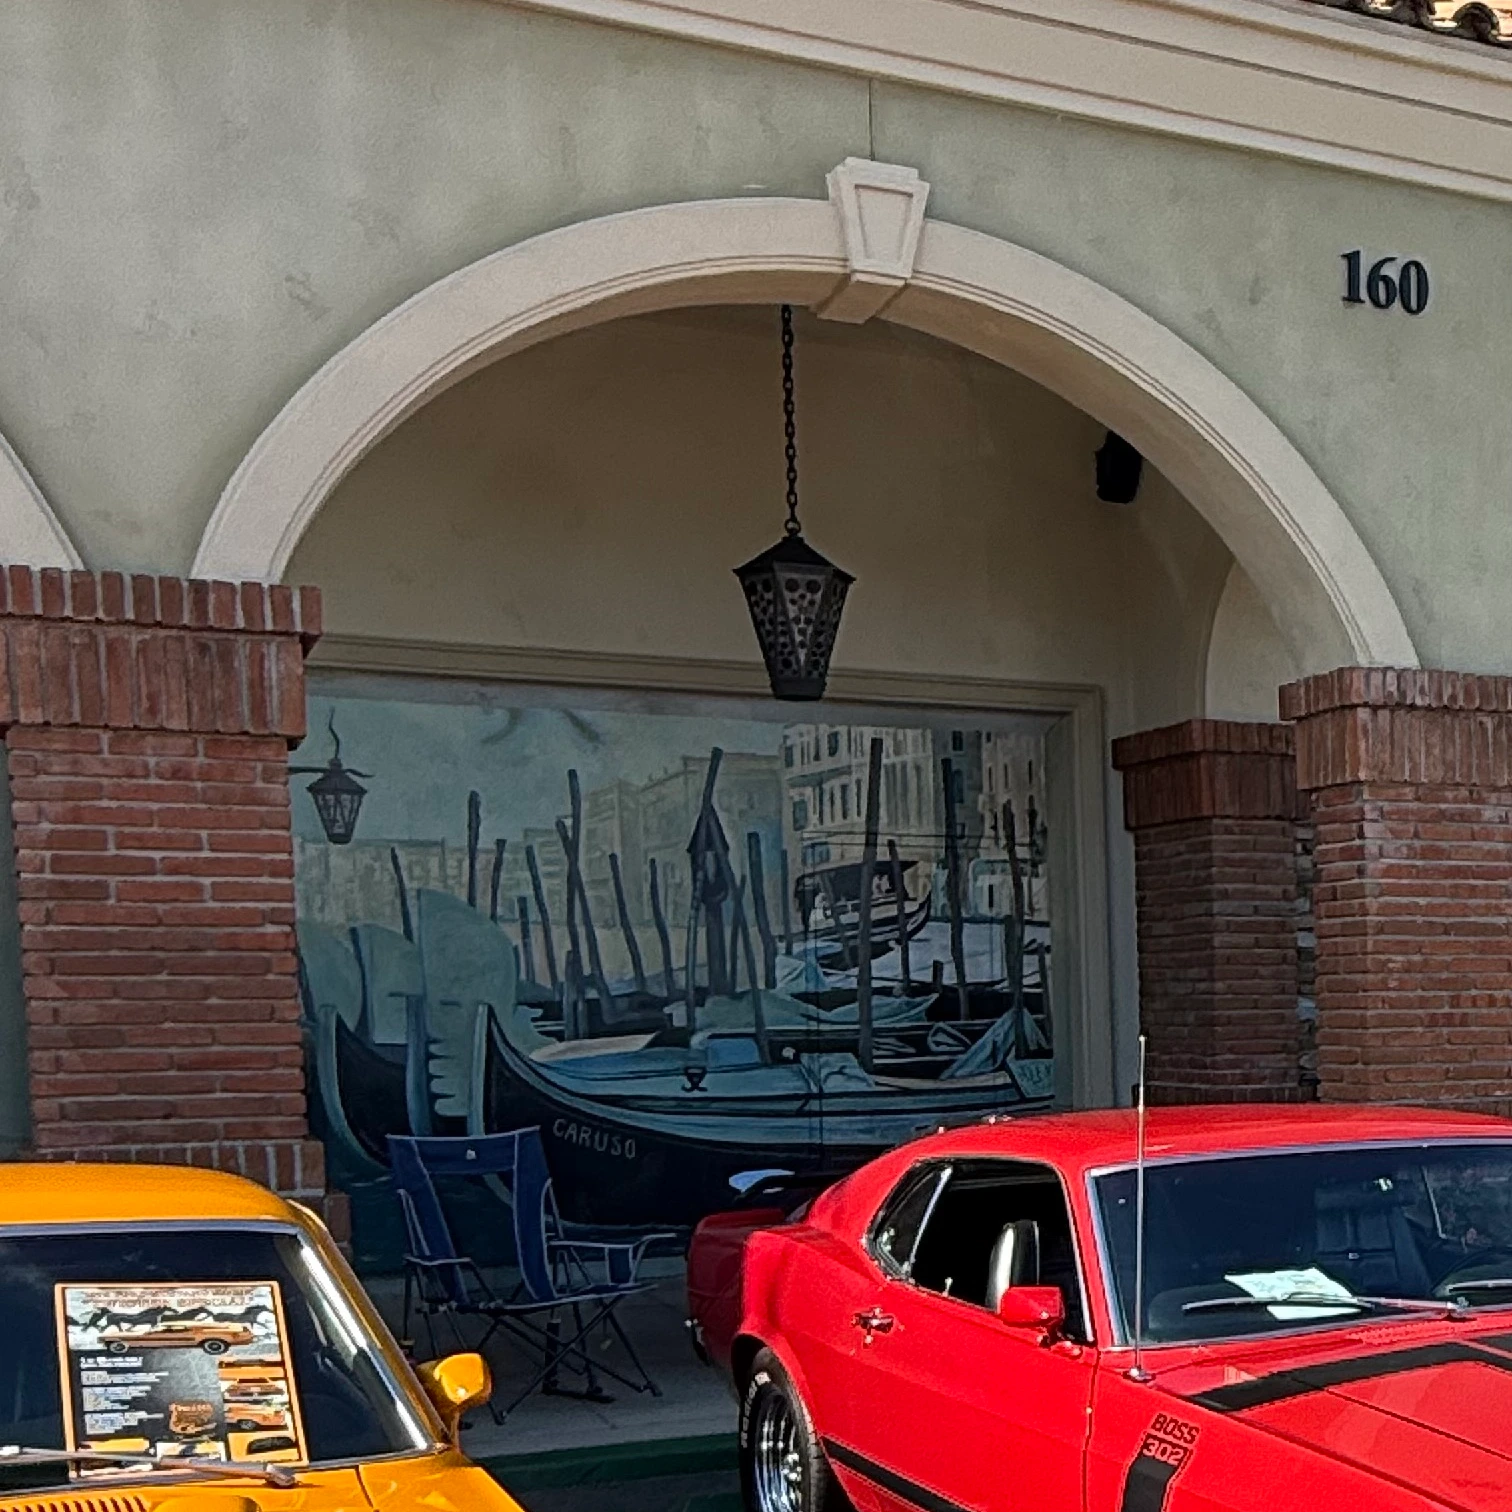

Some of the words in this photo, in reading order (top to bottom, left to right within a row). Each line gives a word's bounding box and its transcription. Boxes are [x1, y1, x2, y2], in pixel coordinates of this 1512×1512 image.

[1340, 249, 1430, 316] 160
[552, 1118, 637, 1160] CARUSO
[1151, 1412, 1200, 1445] BOSS
[1142, 1437, 1185, 1467] 302
